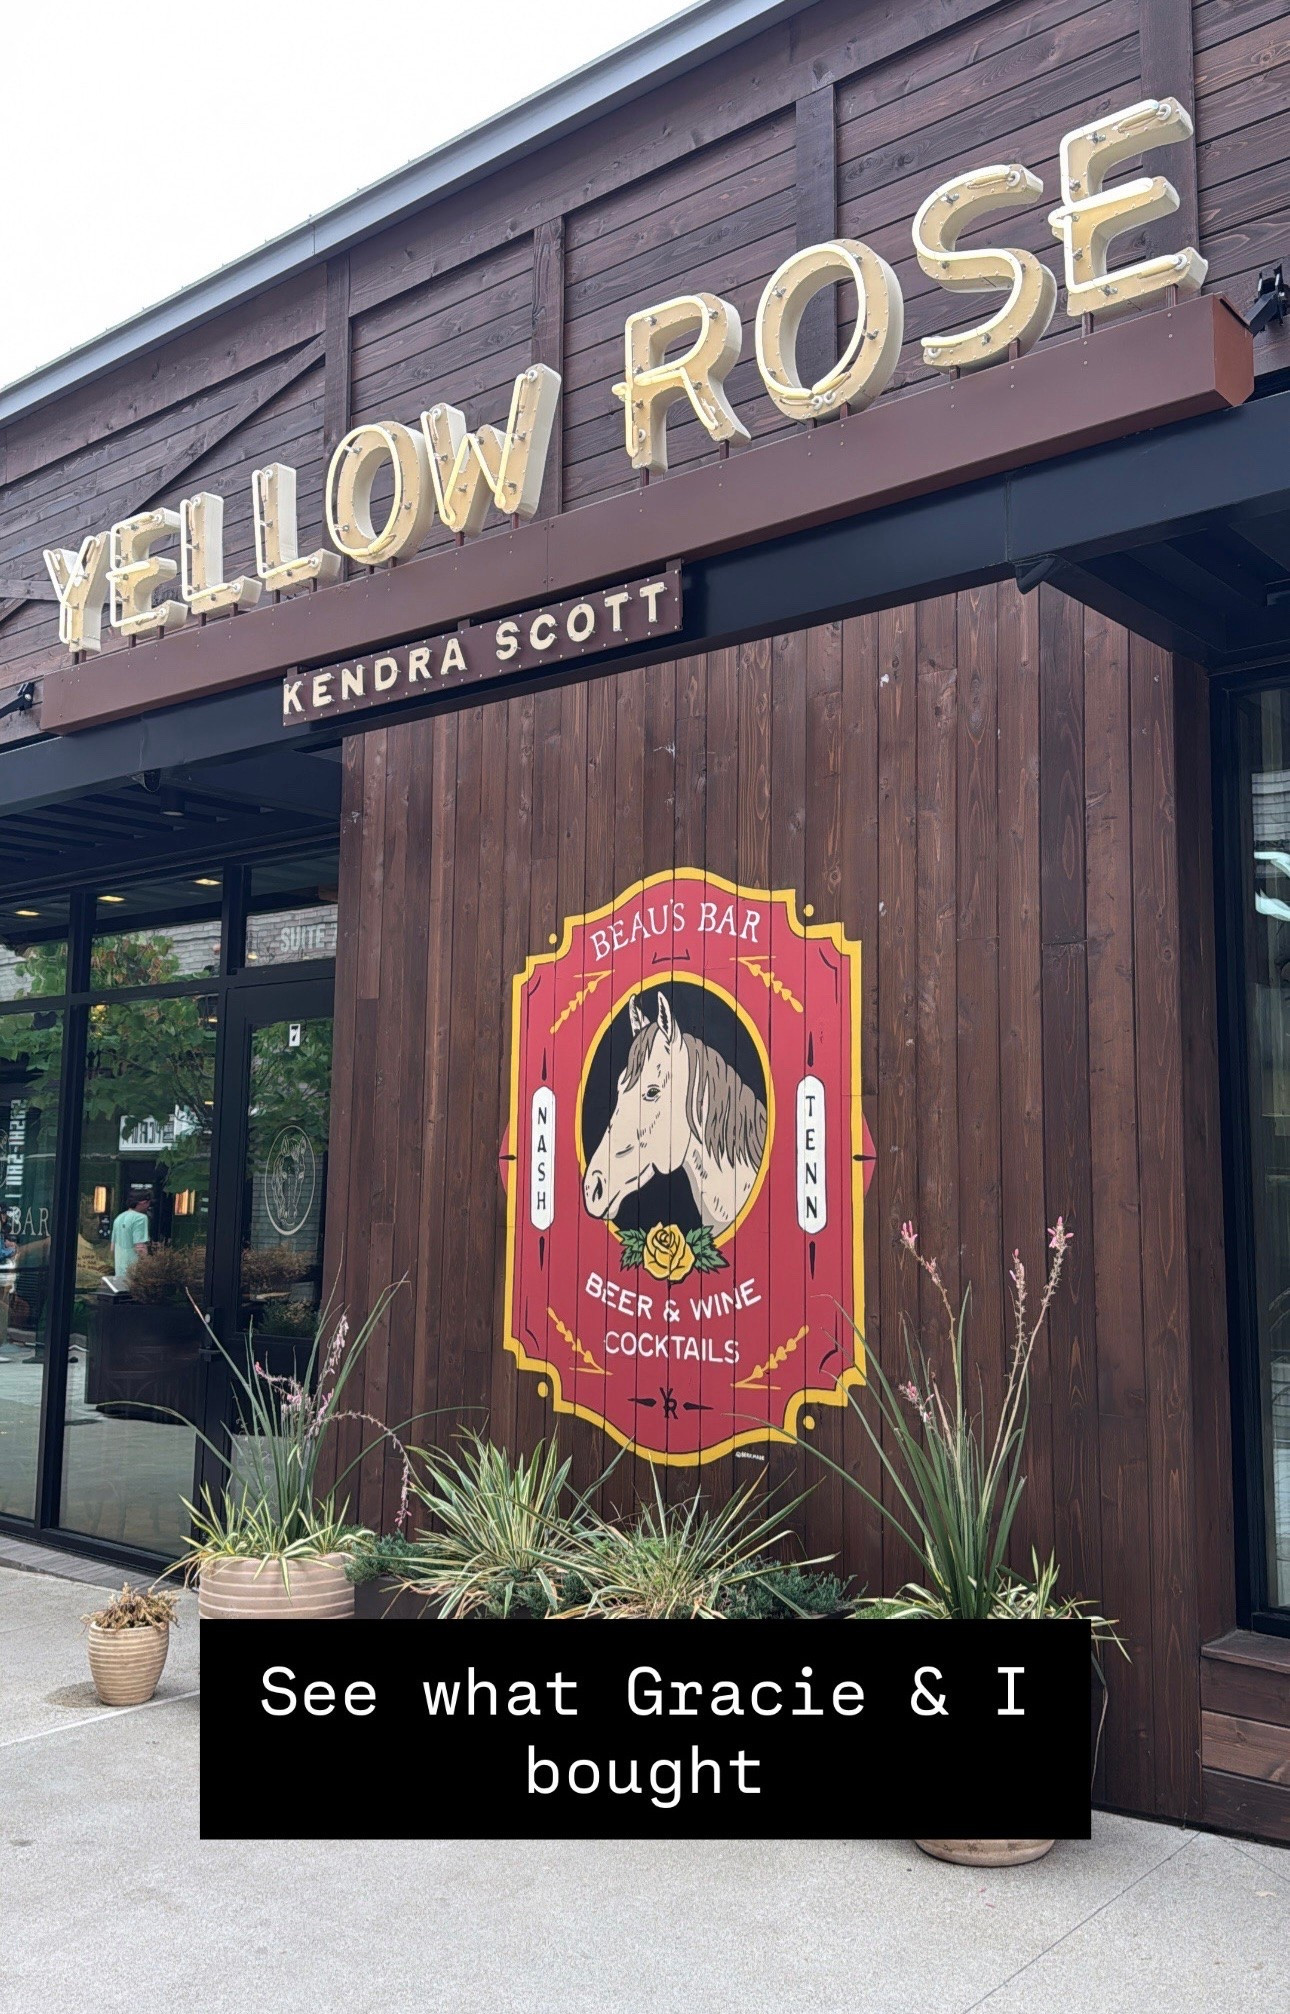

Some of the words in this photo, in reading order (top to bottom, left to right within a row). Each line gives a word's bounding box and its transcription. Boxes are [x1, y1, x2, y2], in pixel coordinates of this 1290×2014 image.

[43, 363, 563, 652] YELLOW
[612, 97, 1208, 473] ROSE
[283, 638, 468, 714] KENDRA
[496, 582, 669, 660] SCOTT
[281, 924, 325, 952] SUITE
[589, 899, 686, 962] BEAU'S
[698, 902, 760, 943] BAR
[291, 1025, 298, 1041] 7
[537, 1106, 548, 1211] NASH
[805, 1096, 818, 1219] TENN
[9, 1206, 50, 1236] BAR
[585, 1272, 653, 1320] BEER
[663, 1299, 680, 1322] &
[690, 1278, 762, 1320] WINE
[605, 1331, 740, 1364] COCKTAILS
